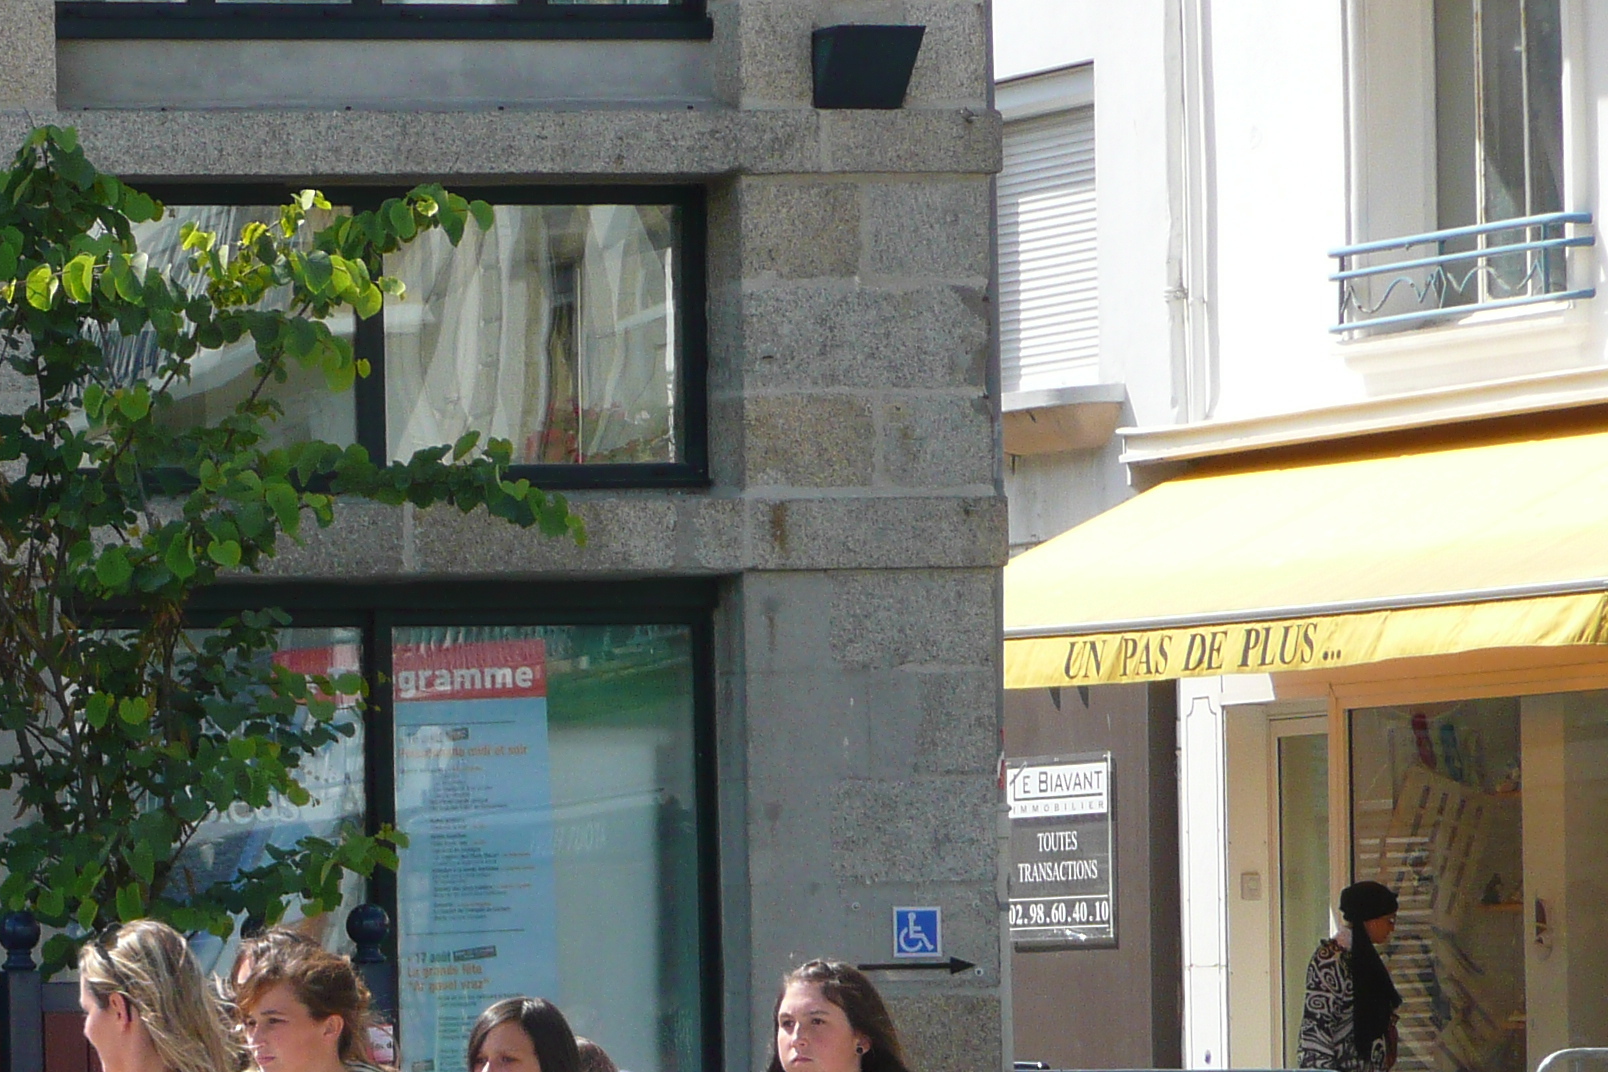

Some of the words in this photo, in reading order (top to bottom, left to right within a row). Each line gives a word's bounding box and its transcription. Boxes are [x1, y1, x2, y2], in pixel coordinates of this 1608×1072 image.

[1064, 640, 1107, 679] UN
[1119, 635, 1172, 677] PAS
[1180, 630, 1228, 672] DE
[1237, 623, 1342, 668] PLUS...
[1038, 770, 1103, 793] BIAVANT
[1013, 800, 1105, 815] IMMOBILIER
[1037, 831, 1078, 852] TOUTES
[1018, 860, 1098, 883] TRANSACTIONS
[1009, 900, 1109, 925] 02.98.60.40.10
